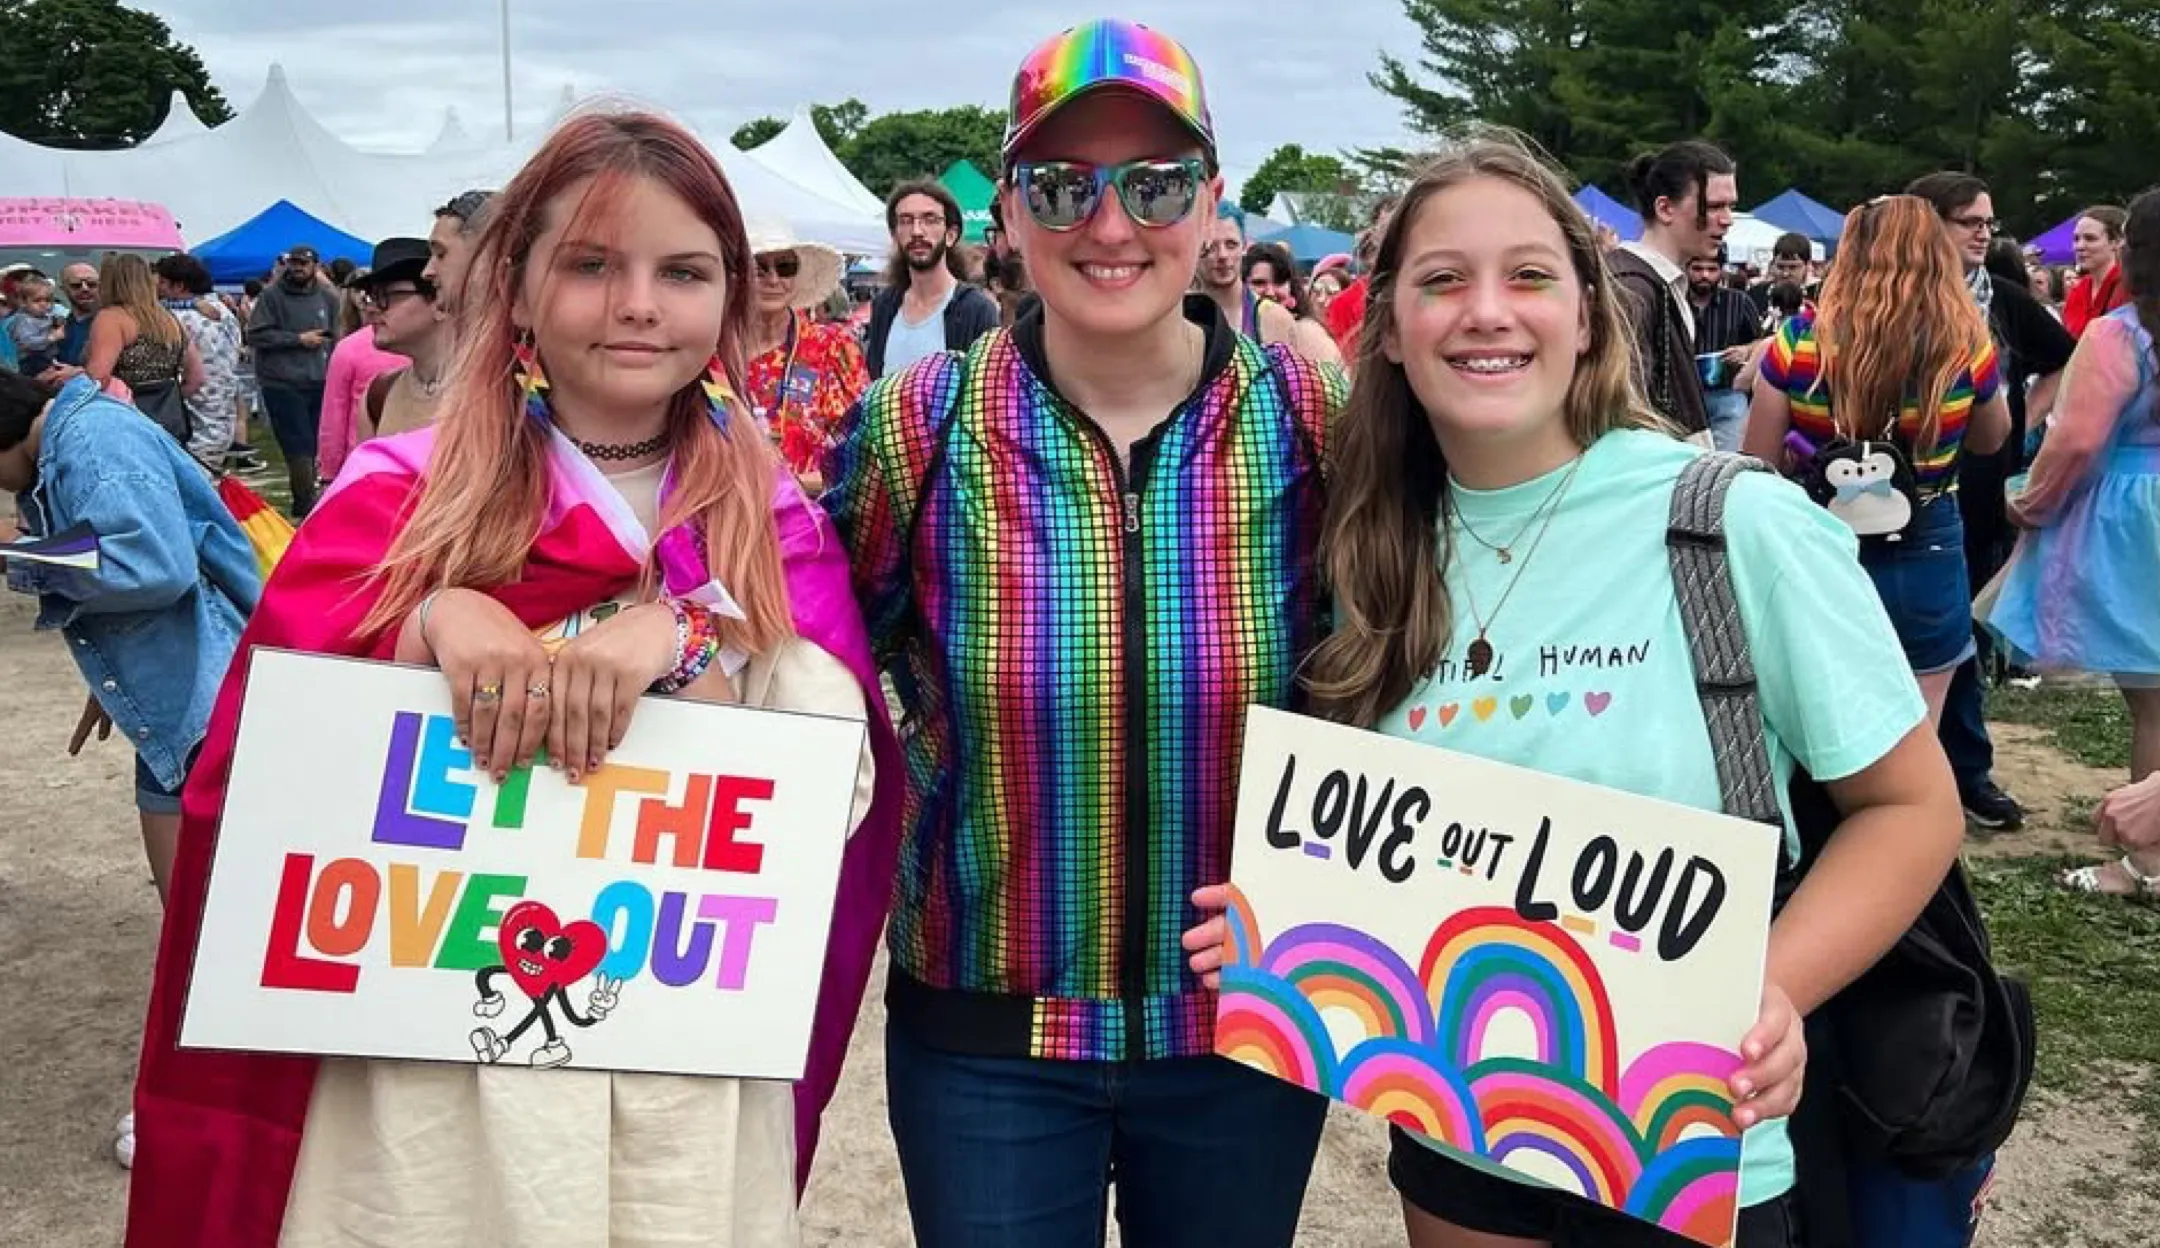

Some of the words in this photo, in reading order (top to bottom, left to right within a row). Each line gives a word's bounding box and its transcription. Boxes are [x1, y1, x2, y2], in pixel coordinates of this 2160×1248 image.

[1540, 639, 1650, 676] HUMAN
[371, 711, 550, 850] LET
[568, 763, 774, 873] THE
[1266, 753, 1431, 883] LOVE
[1441, 823, 1513, 880] OUT
[1514, 816, 1726, 961] LOUD
[260, 852, 527, 993] LOVE
[590, 880, 778, 990] OUT
